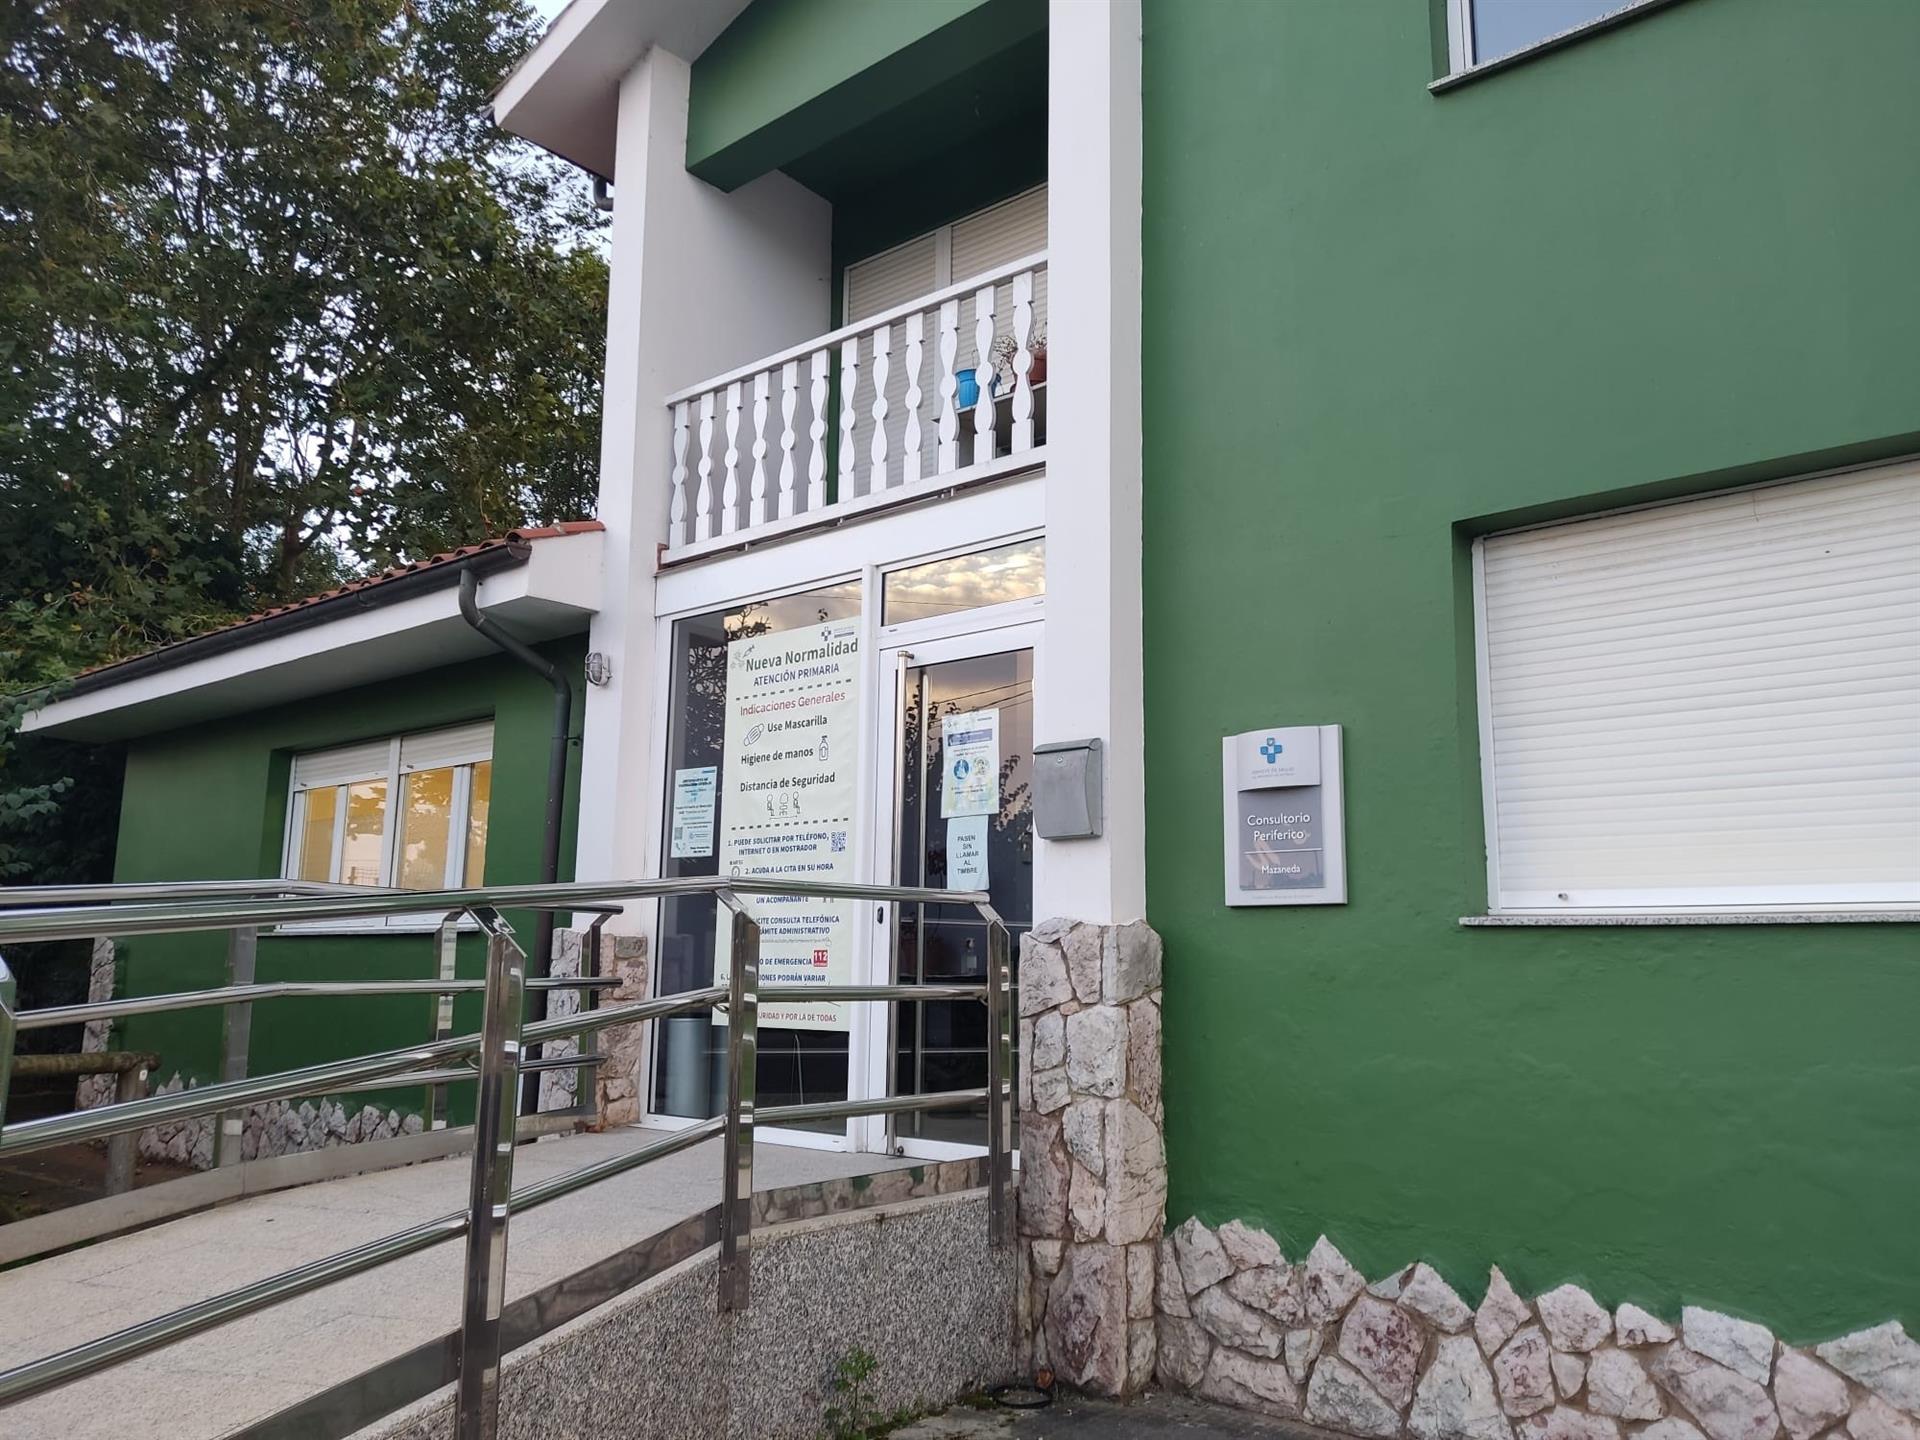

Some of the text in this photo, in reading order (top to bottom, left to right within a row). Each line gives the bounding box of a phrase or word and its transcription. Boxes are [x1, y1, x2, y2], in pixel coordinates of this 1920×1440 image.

[746, 638, 858, 672] Nueva Normalidad
[754, 663, 839, 686] ATENCIÓN PRIMARIA
[740, 691, 845, 716] Indicaciones Generales
[767, 715, 827, 732] Use Mascarilla
[741, 748, 814, 766] Higiene de manos
[740, 772, 835, 792] Distancia de Seguridad
[1247, 813, 1310, 826] Consultorio
[734, 838, 751, 846] PUEDE
[753, 836, 780, 845] SOLICITAR
[738, 847, 765, 856] INTERNET
[772, 846, 779, 854] EN
[781, 844, 817, 853] MOSTRADOR
[751, 866, 770, 874] ACUDA
[775, 865, 782, 873] LA
[816, 862, 834, 870] HORA
[802, 914, 840, 924] TELEFÓNICA
[759, 926, 830, 935] ÁMITE ADMINISTRATIVO
[774, 958, 812, 966] EMERGENCIA
[814, 951, 828, 961] 112
[778, 973, 802, 981] PODRÁN
[803, 974, 826, 982] VARIAR
[759, 1011, 780, 1020] URIDAD
[800, 1013, 806, 1021] LA
[817, 1014, 837, 1022] TODAS
